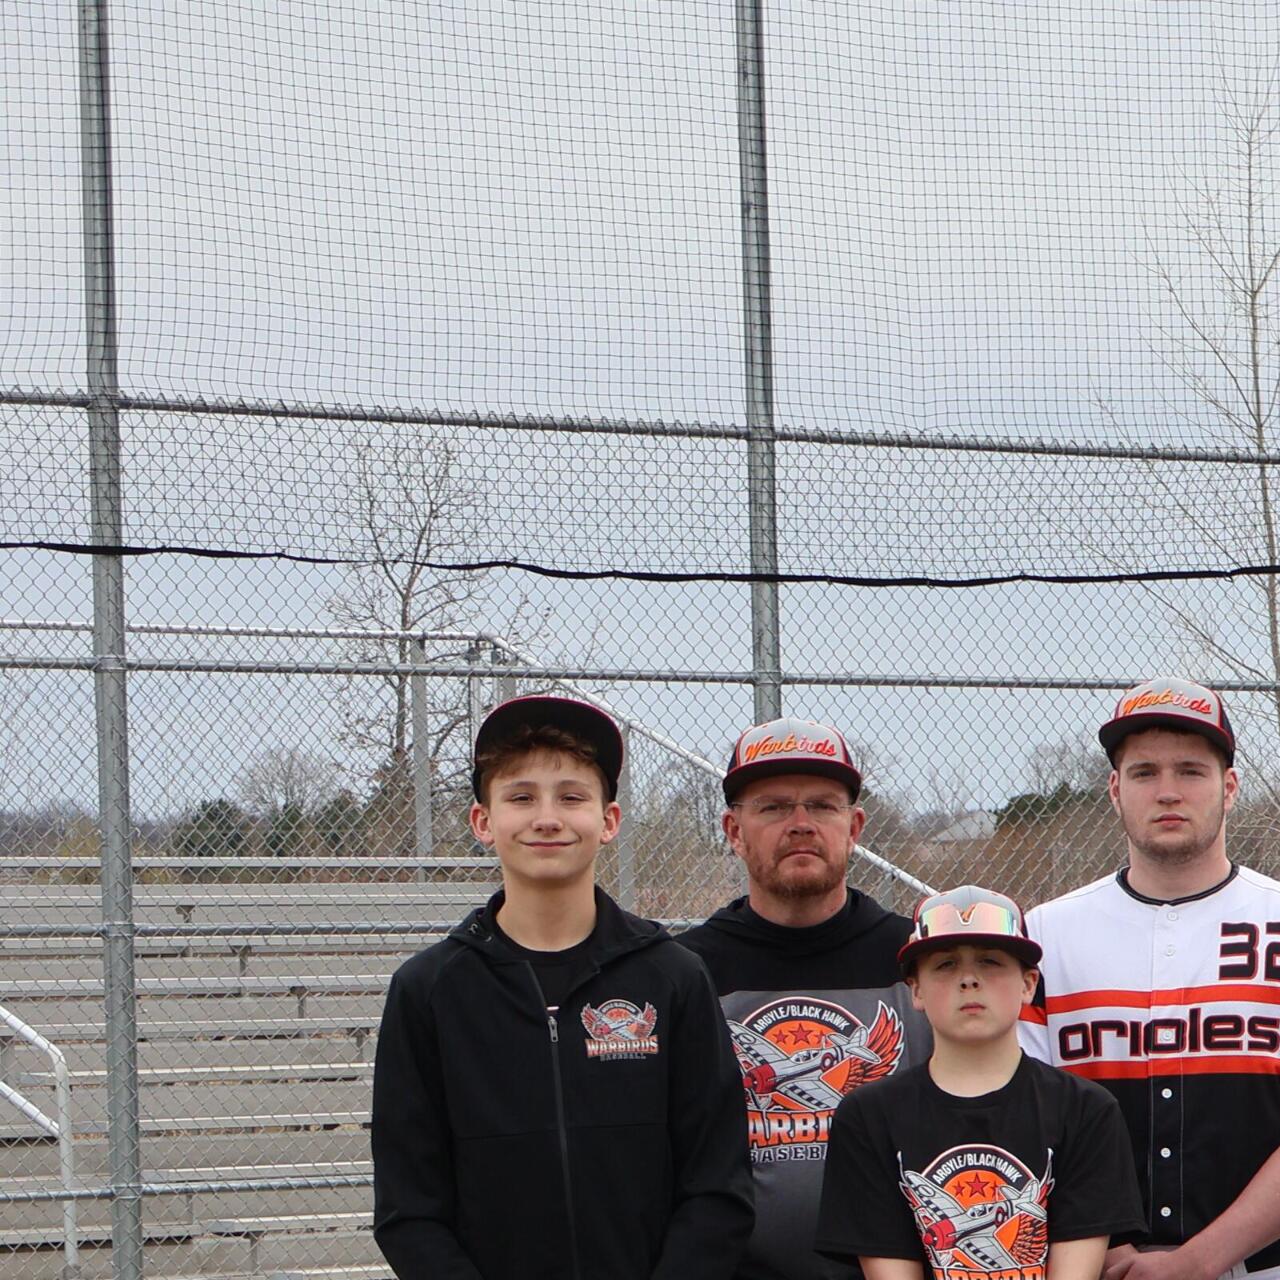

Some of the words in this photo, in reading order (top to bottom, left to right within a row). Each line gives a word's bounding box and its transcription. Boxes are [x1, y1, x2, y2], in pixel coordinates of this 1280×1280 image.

[1120, 689, 1212, 715] Warbirds
[744, 734, 836, 763] Warbirds
[753, 1005, 822, 1033] ARGYLE/BLACK
[820, 1009, 850, 1031] HAWK
[585, 1036, 659, 1058] WARBIRDS
[1058, 1007, 1280, 1060] orioles
